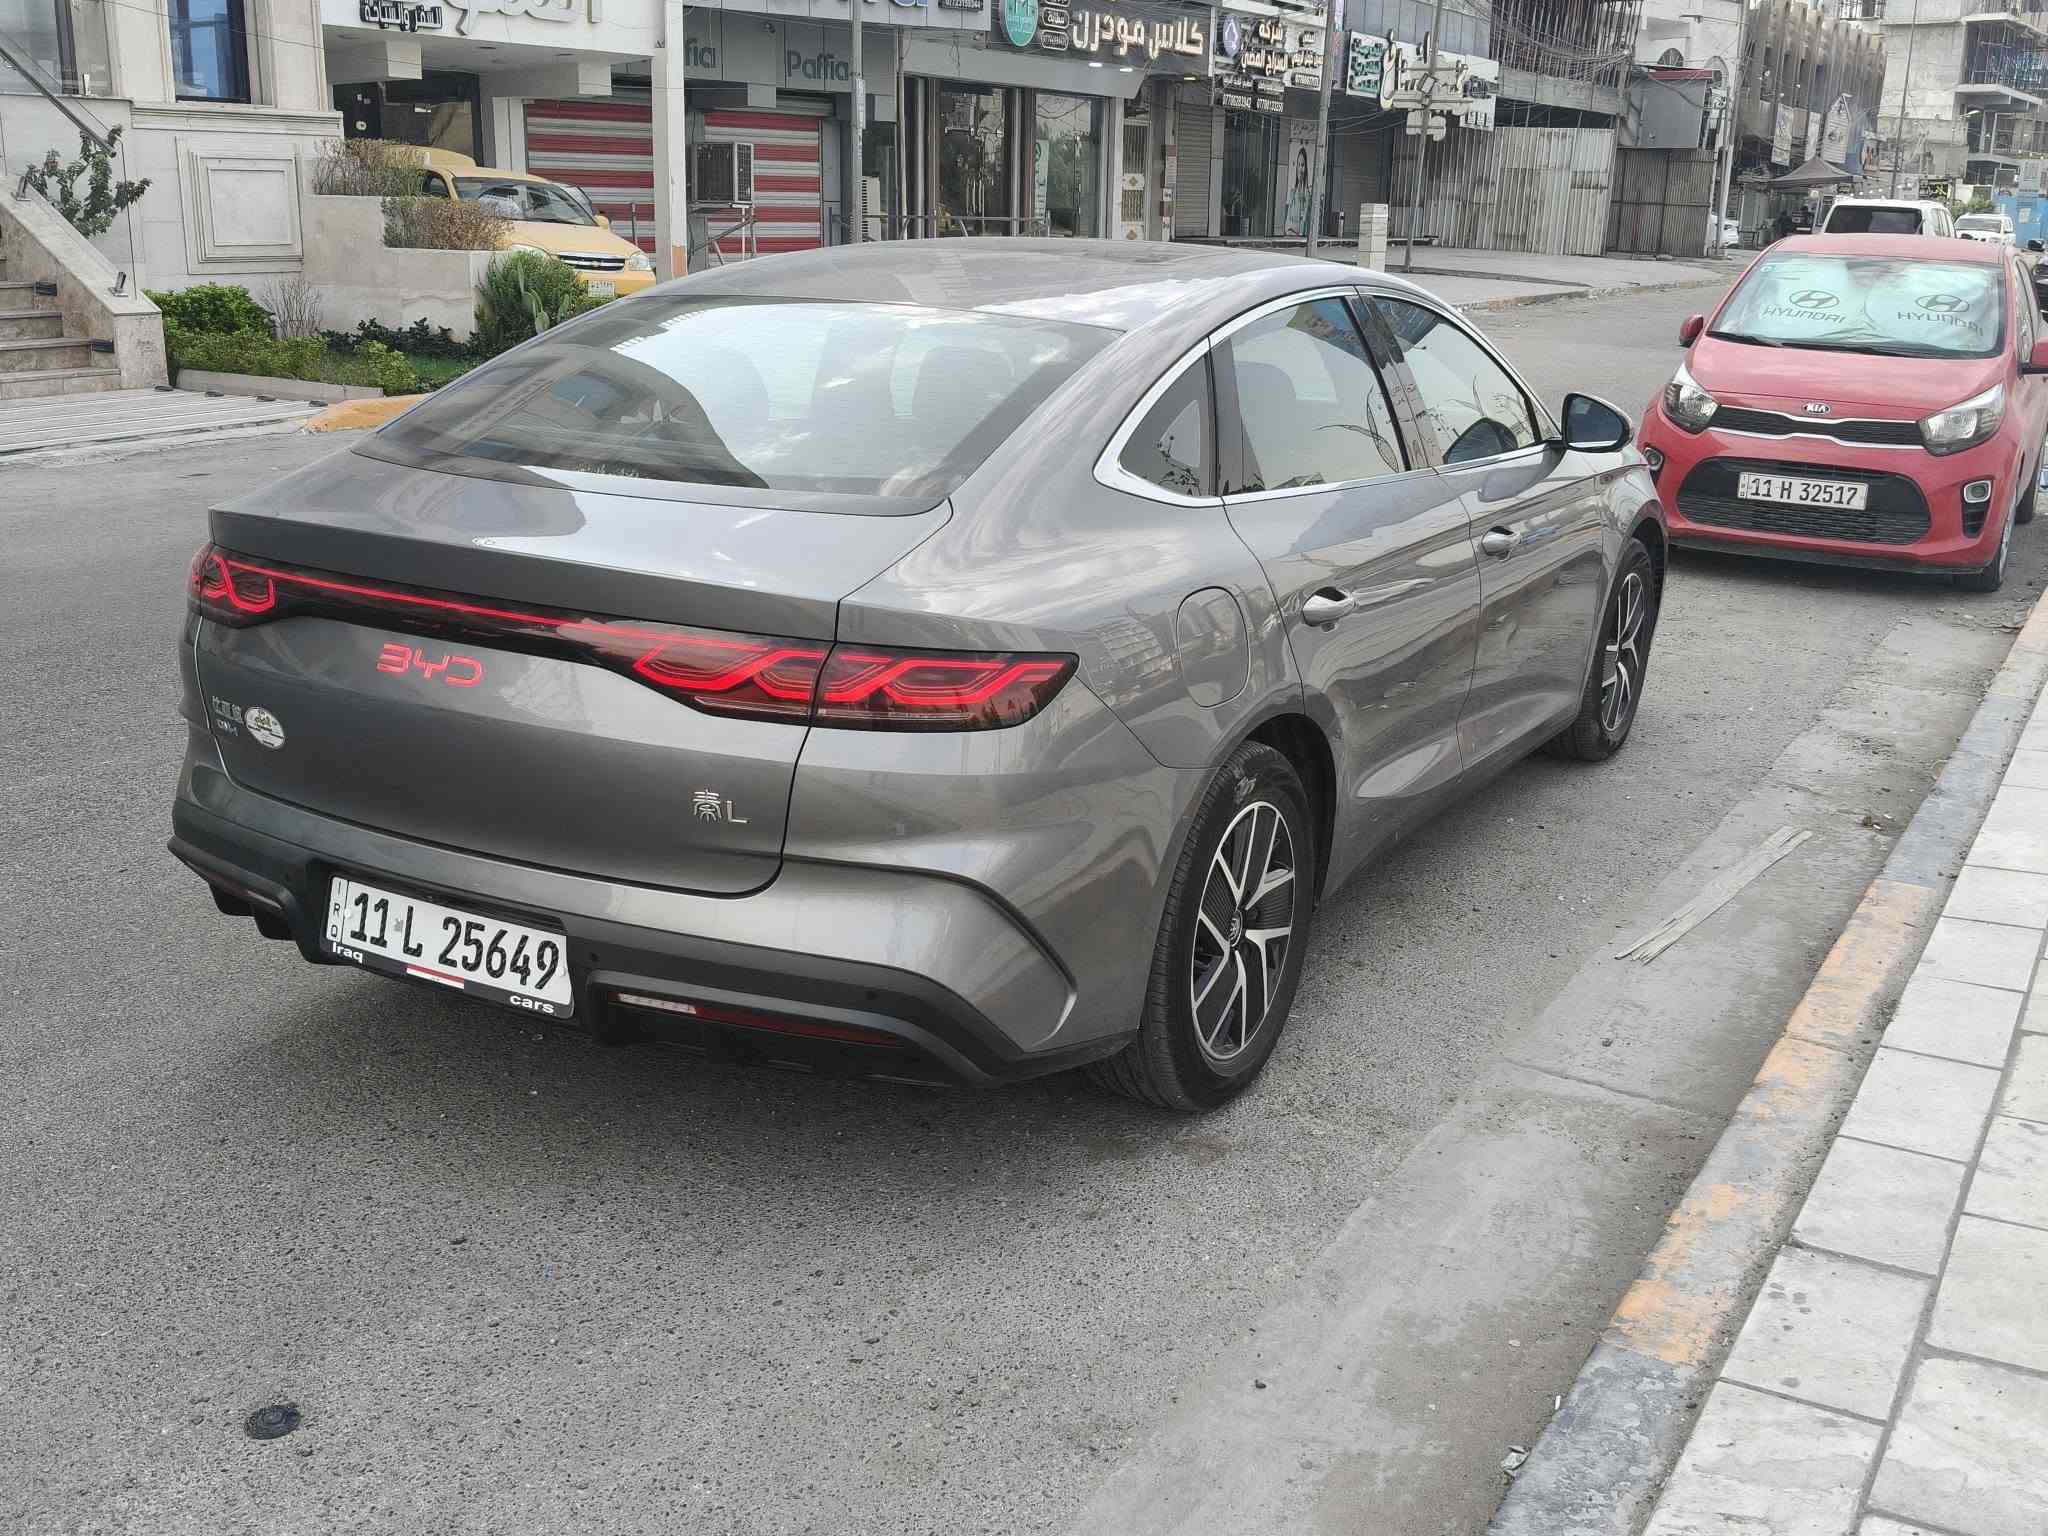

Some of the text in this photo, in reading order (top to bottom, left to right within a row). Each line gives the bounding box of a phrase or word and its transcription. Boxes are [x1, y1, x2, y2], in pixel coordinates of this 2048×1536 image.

[1763, 304, 1847, 325] HYUNDAI
[1896, 311, 1984, 337] HYUNDAI
[1806, 402, 1827, 413] KIA
[1750, 477, 1772, 498] 11
[1779, 480, 1793, 500] H
[1799, 482, 1859, 506] 32517
[376, 642, 483, 688] BYD
[350, 892, 560, 990] 11 L 25649
[332, 941, 555, 1014] Iraq cars
